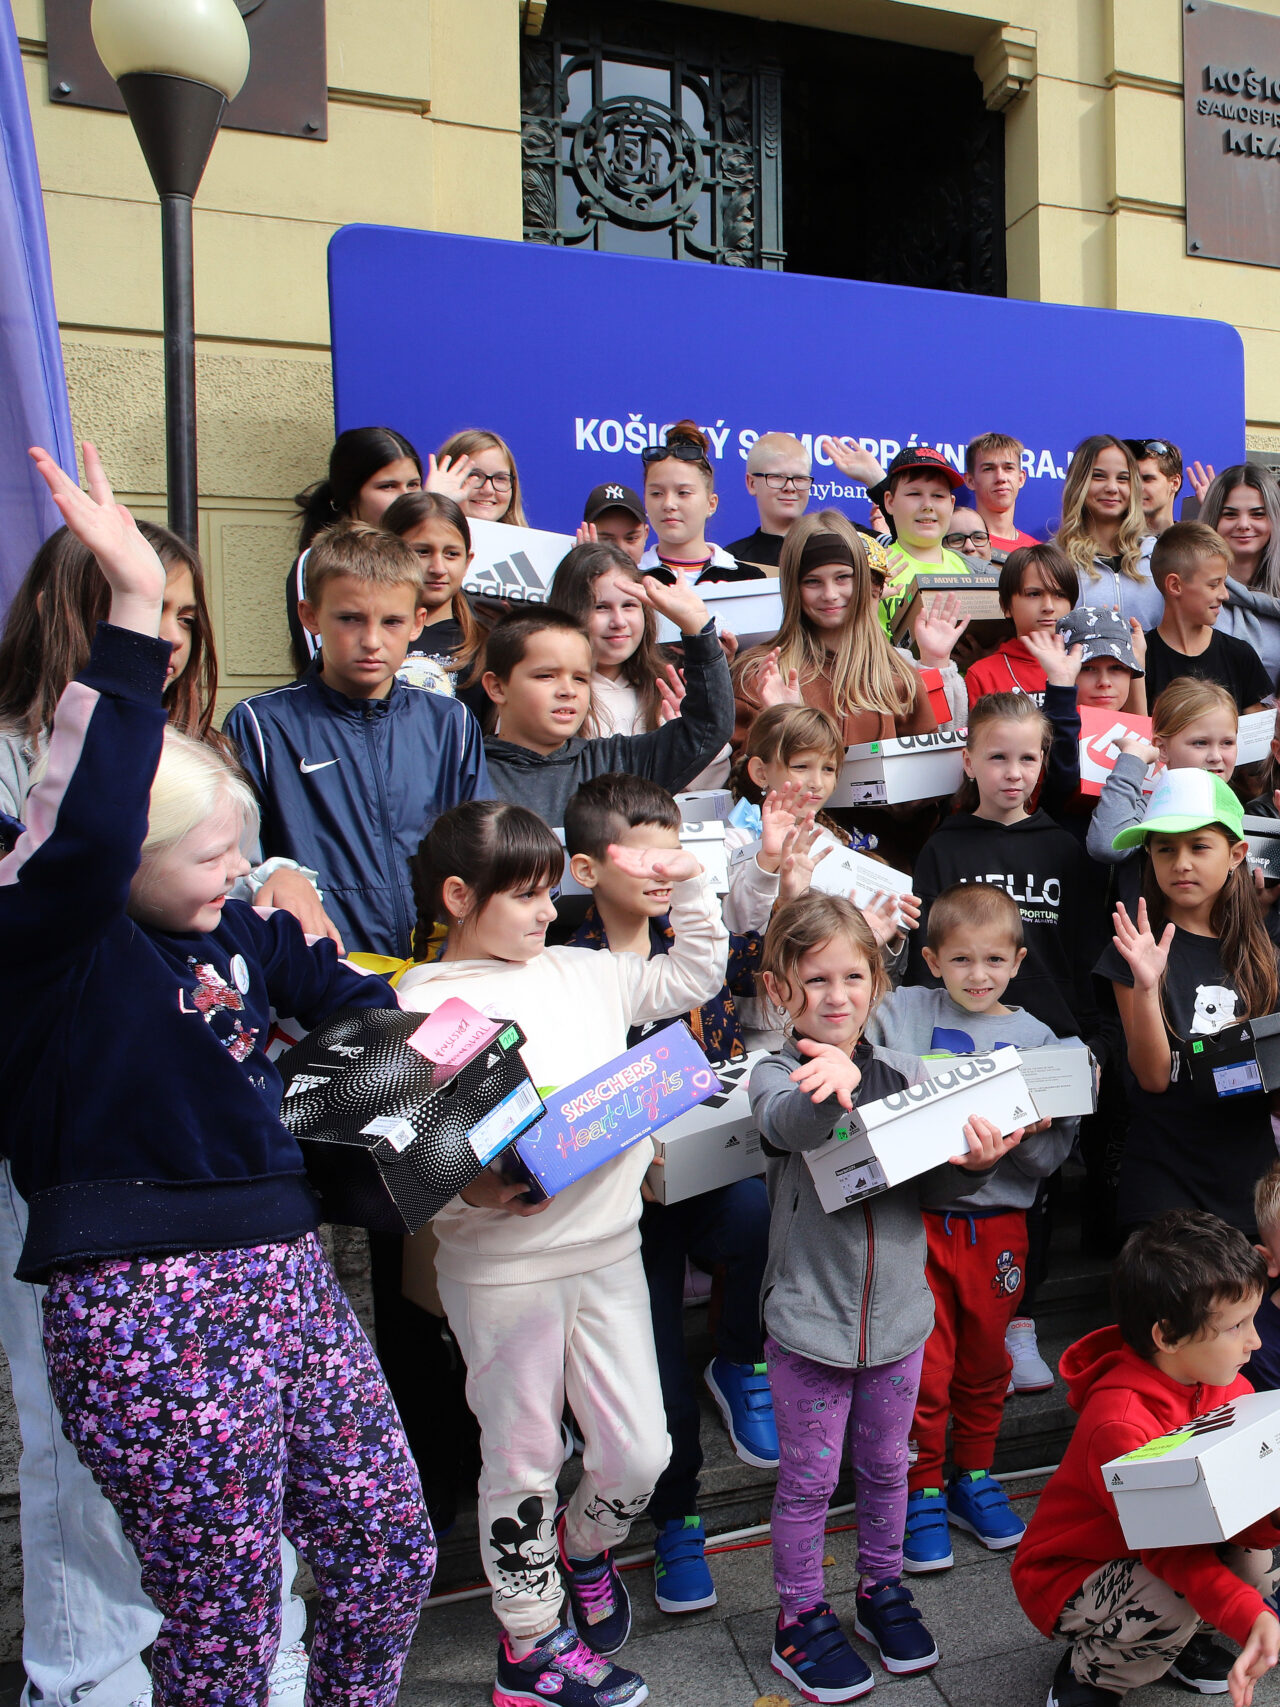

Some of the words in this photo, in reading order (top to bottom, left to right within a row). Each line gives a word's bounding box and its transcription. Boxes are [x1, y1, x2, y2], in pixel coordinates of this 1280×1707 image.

[575, 413, 730, 459] KOŠIÝ
[464, 578, 546, 603] adida
[934, 576, 959, 584] MOVE
[960, 576, 971, 584] TO
[975, 576, 996, 584] ZERO
[960, 873, 1061, 907] LLO
[560, 1054, 657, 1123] SKECHERS
[556, 1104, 618, 1159] Heart
[623, 1070, 684, 1121] Lights
